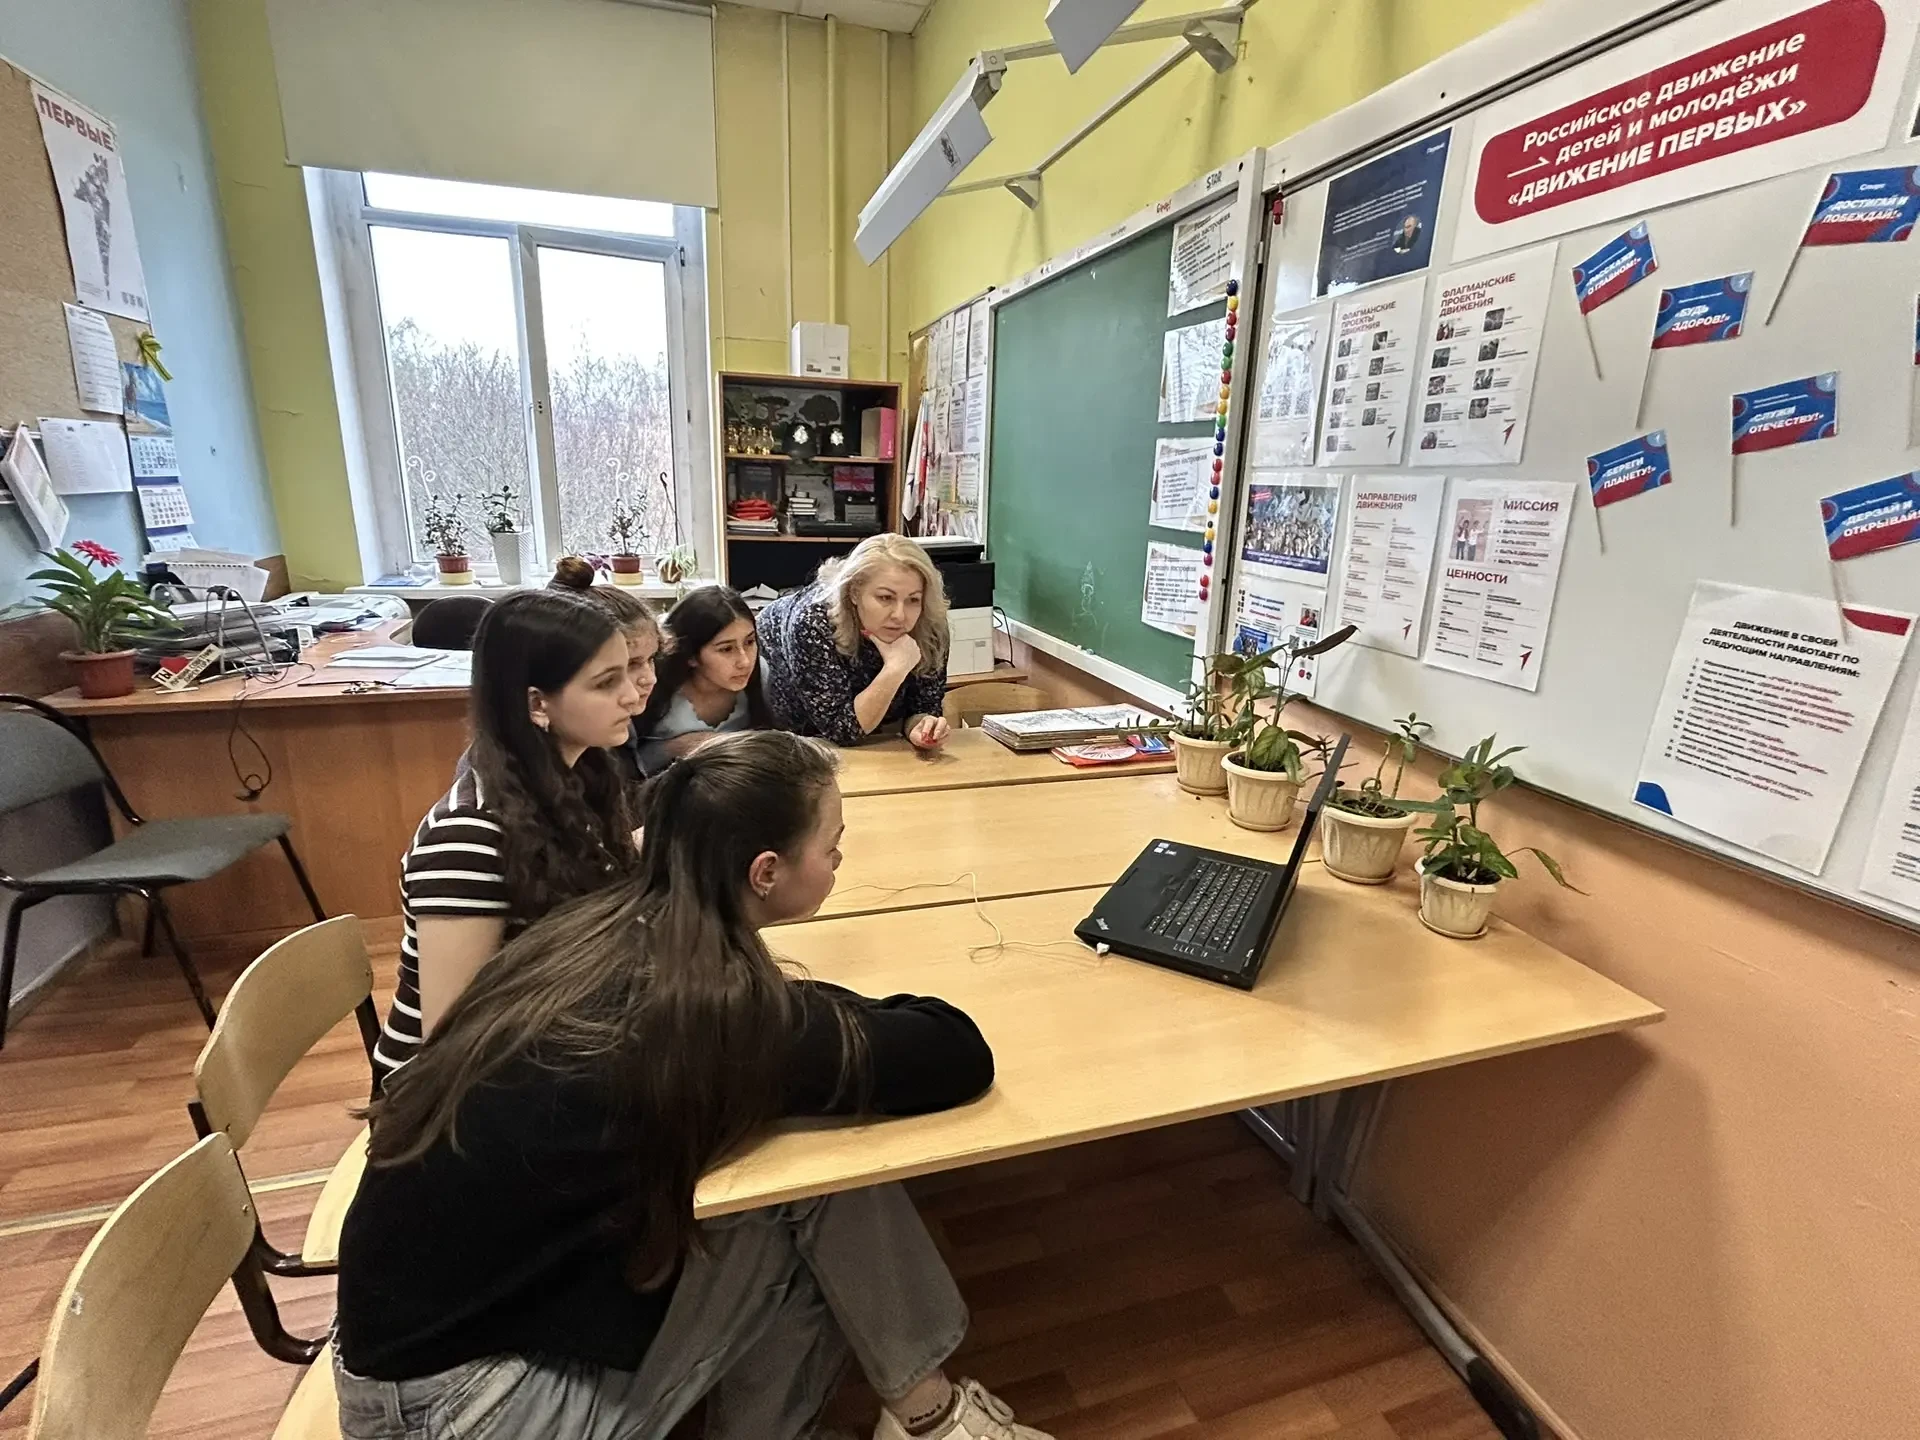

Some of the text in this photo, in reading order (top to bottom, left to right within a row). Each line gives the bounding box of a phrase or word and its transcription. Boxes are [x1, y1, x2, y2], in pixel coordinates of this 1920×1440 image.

[1523, 33, 1806, 153] Российское движение
[37, 94, 115, 153] ПЕРВЫЕ
[1555, 63, 1799, 166] детей и молодёжи
[1507, 97, 1808, 206] «ДВИЖЕНИЕ ПЕРВЫХ»
[1440, 289, 1487, 308] ПРОЕКТЫ
[1442, 272, 1516, 299] ФЛАГМАНСКИЕ
[1439, 297, 1494, 318] ДВИЖЕНИЯ
[1356, 500, 1404, 511] ДВИЖЕНИЯ
[1357, 492, 1418, 503] НАПРАВЛЕНИЯ
[1503, 499, 1560, 512] МИССИЯ
[1446, 567, 1508, 585] ЦЕННОСТИ
[1709, 627, 1860, 665] ДЕЯТЕЛЬНОСТИ РАБОТАЕТ ПО
[1733, 620, 1839, 649] ДВИЖЕНИЕ В СВОЕЙ
[1702, 637, 1768, 660] СЛЕДУЮЩИМ
[1769, 652, 1861, 679] НАПРАВЛЕНИЯМ:
[154, 668, 173, 684] ТЫ
